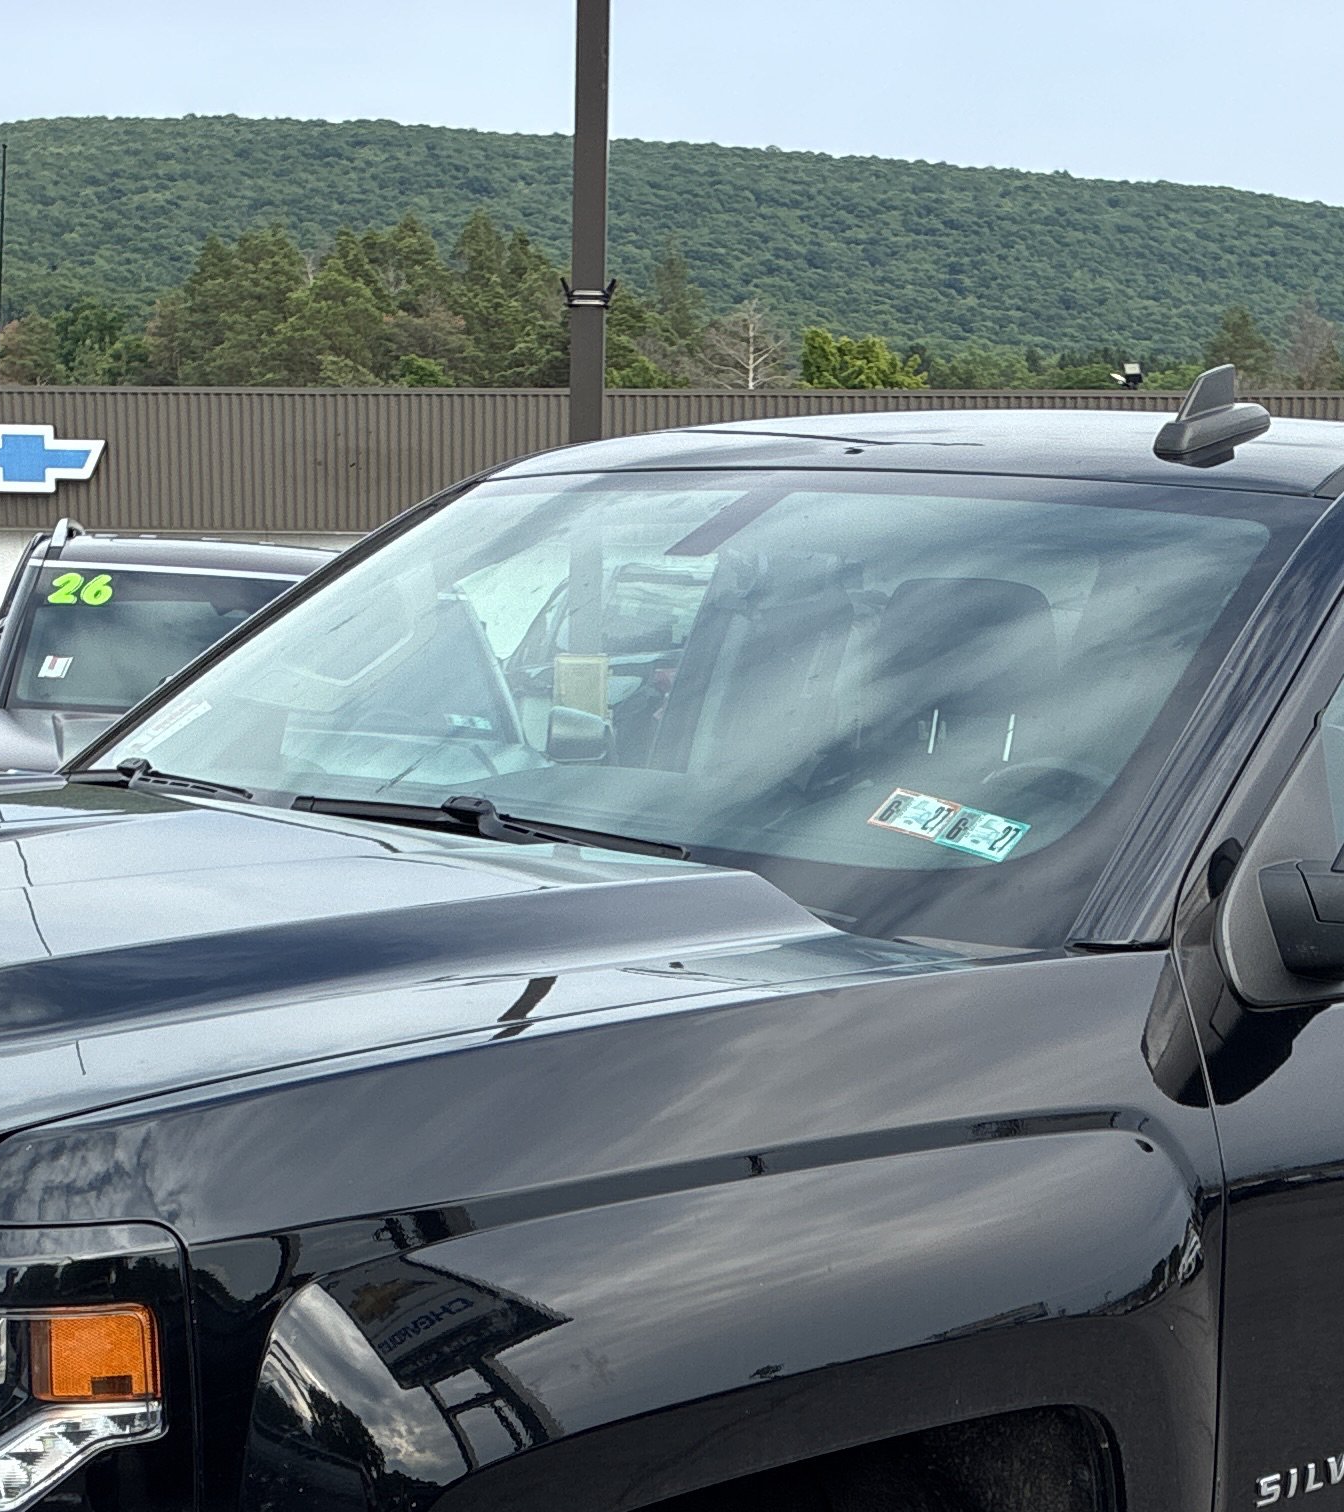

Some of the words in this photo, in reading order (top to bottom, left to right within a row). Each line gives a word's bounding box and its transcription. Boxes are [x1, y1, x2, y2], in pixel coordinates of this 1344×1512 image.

[47, 572, 113, 606] 26
[920, 806, 955, 834] 27
[987, 825, 1022, 854] 27
